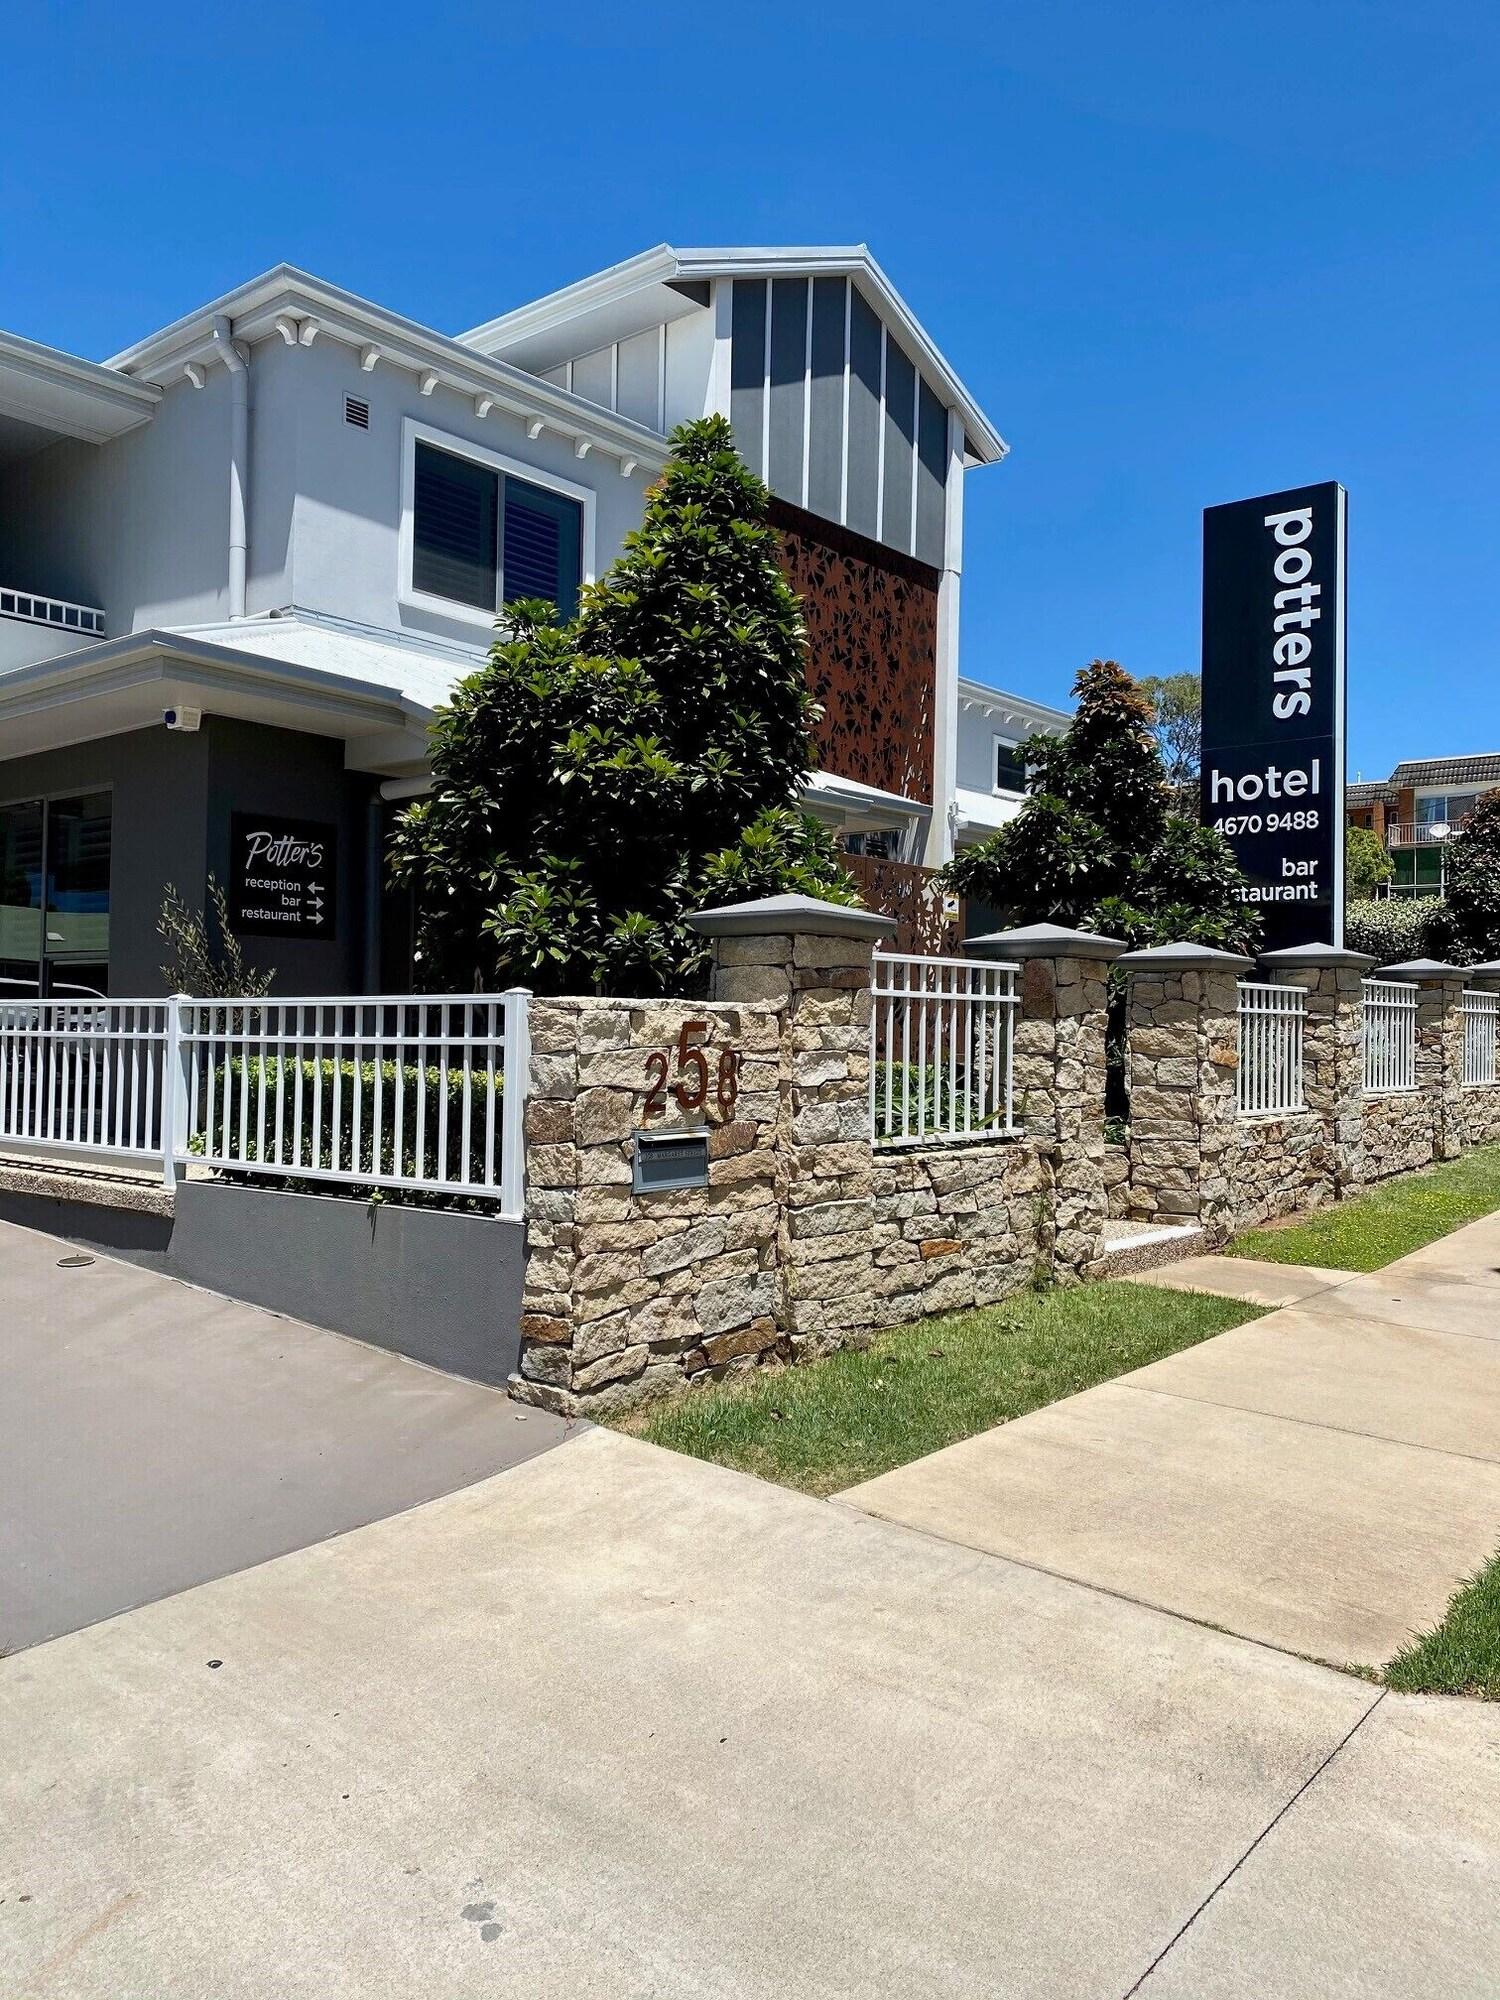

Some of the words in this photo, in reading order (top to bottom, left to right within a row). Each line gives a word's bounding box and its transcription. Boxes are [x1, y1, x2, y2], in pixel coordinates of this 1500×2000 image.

[1265, 507, 1320, 719] potters
[1211, 759, 1320, 803] hotel
[1212, 815, 1262, 836] 4670
[1266, 810, 1319, 832] 9488
[245, 831, 324, 869] Potter's
[1282, 857, 1318, 877] bar
[245, 878, 301, 892] reception
[281, 894, 301, 907] bar
[241, 908, 302, 922] restaurant
[643, 1021, 737, 1114] 258
